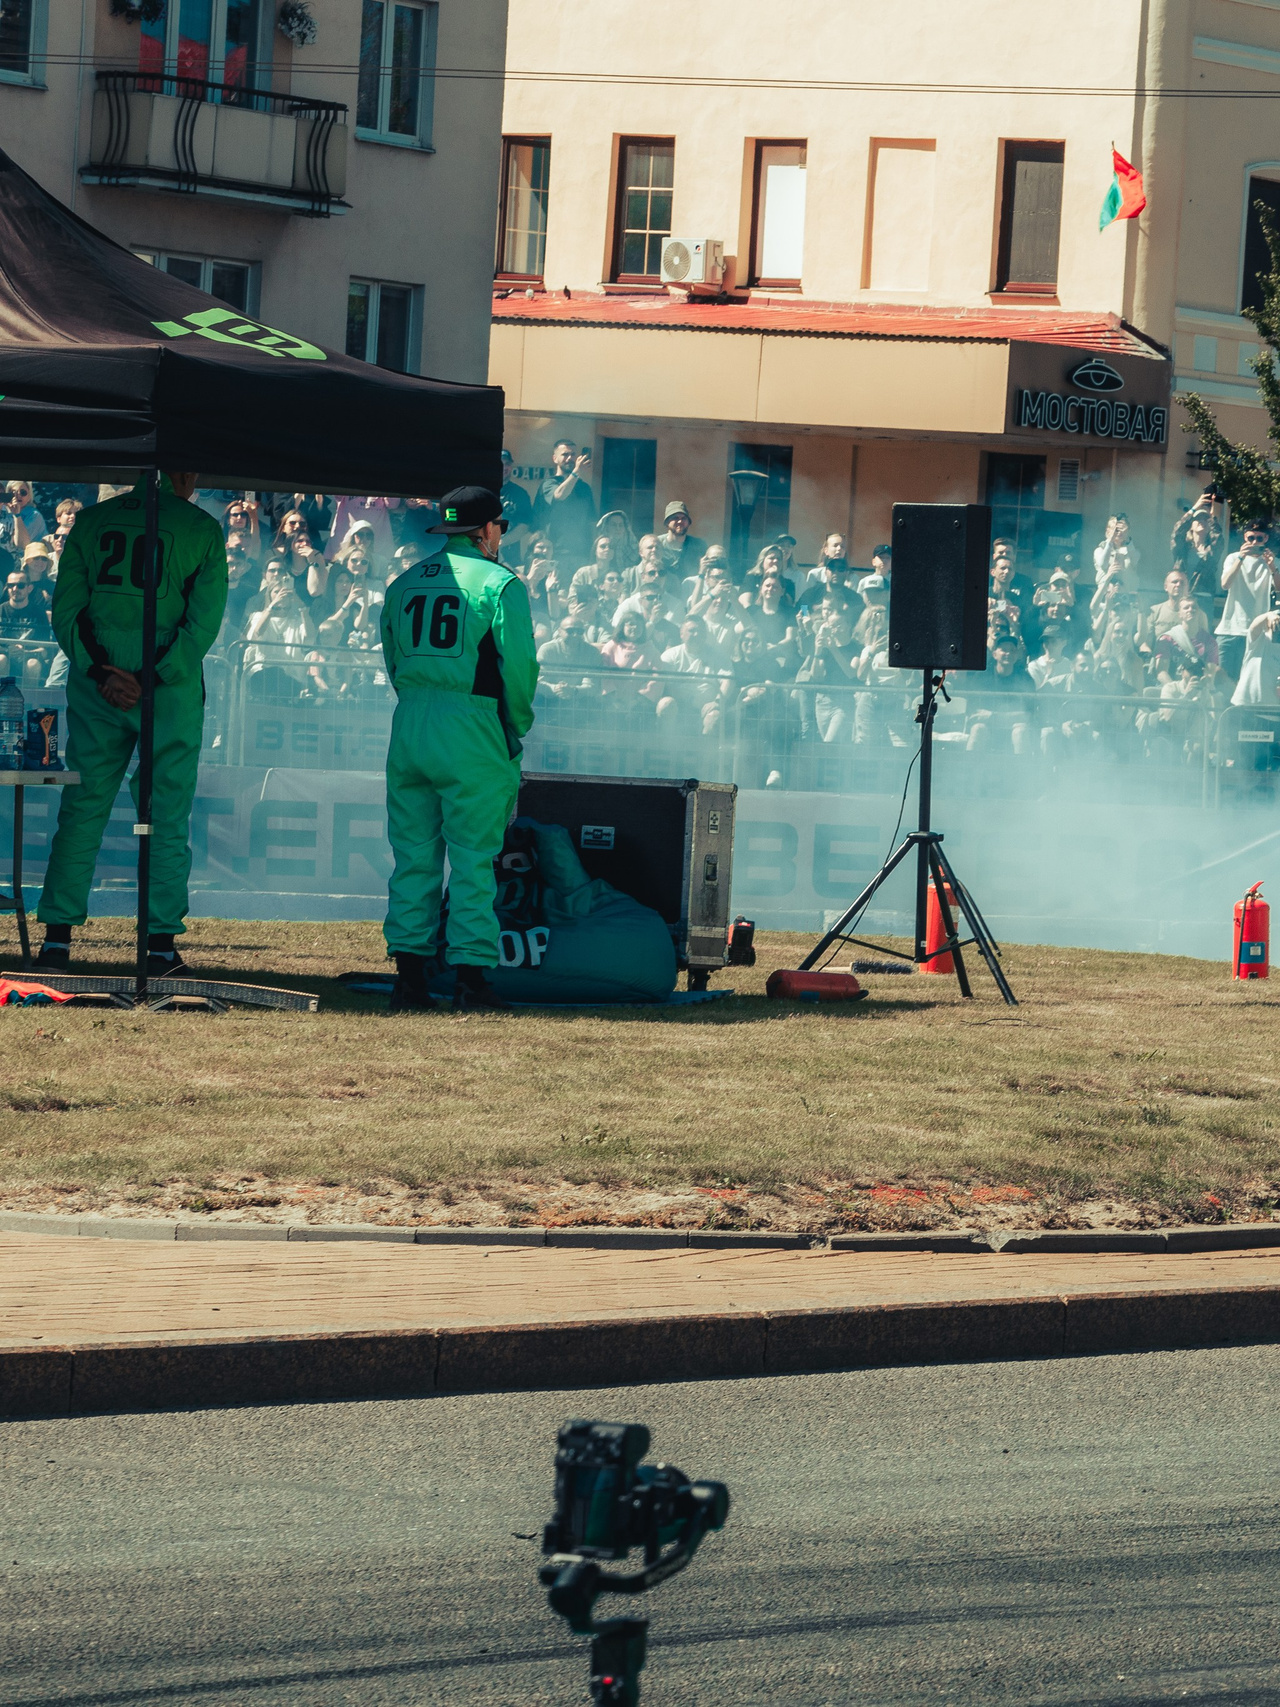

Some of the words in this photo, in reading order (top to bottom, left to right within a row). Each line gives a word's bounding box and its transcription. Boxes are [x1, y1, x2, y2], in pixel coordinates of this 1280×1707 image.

[1021, 389, 1168, 444] МОСТОВАЯ
[510, 466, 552, 480] ОДНА
[97, 531, 164, 590] 20
[404, 594, 460, 649] 16
